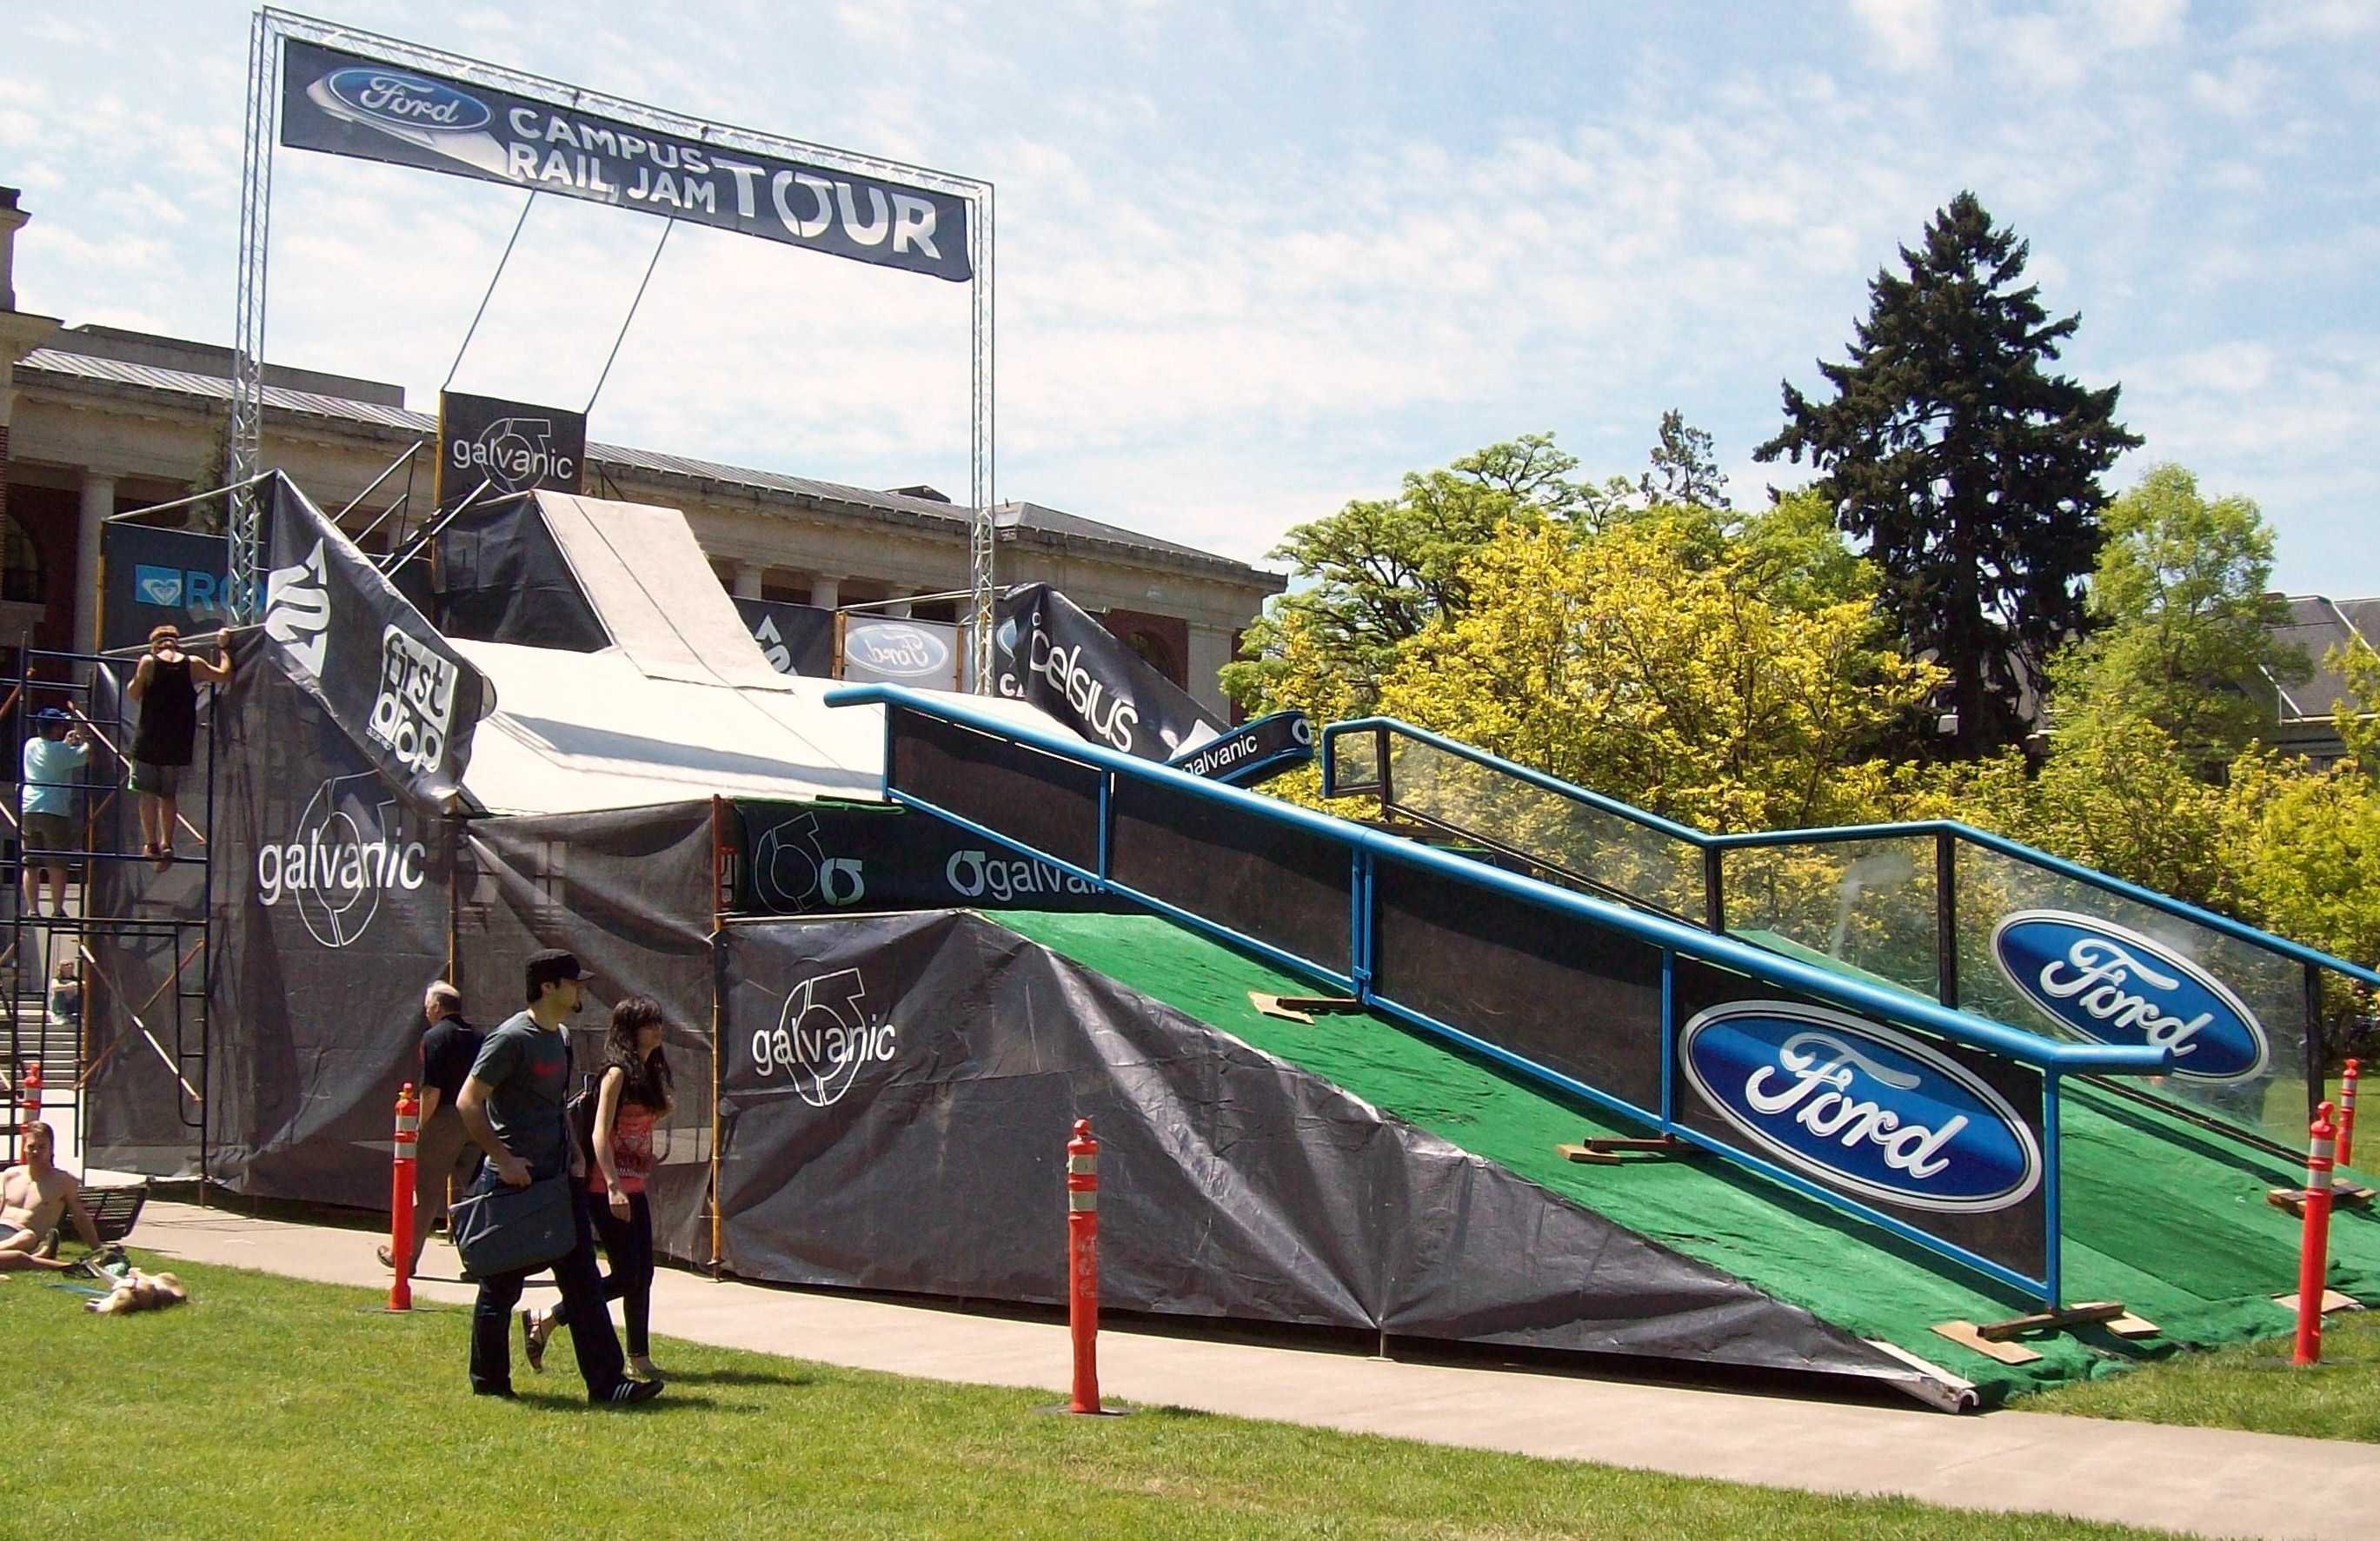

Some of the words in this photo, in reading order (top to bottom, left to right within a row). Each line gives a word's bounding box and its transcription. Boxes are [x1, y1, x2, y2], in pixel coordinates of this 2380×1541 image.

[360, 76, 459, 124] Ford
[509, 107, 710, 174] CAMPUS
[509, 142, 614, 193] RAIL
[626, 167, 715, 214] JAM
[711, 157, 941, 259] TOUR
[453, 438, 573, 479] galvanic
[384, 633, 443, 717] first
[374, 688, 444, 774] drop
[258, 827, 425, 906] galvanic
[986, 857, 1116, 901] galva
[2039, 939, 2213, 1058] Ford
[752, 1013, 895, 1076] galvanic
[1745, 1033, 1968, 1180] Ford
